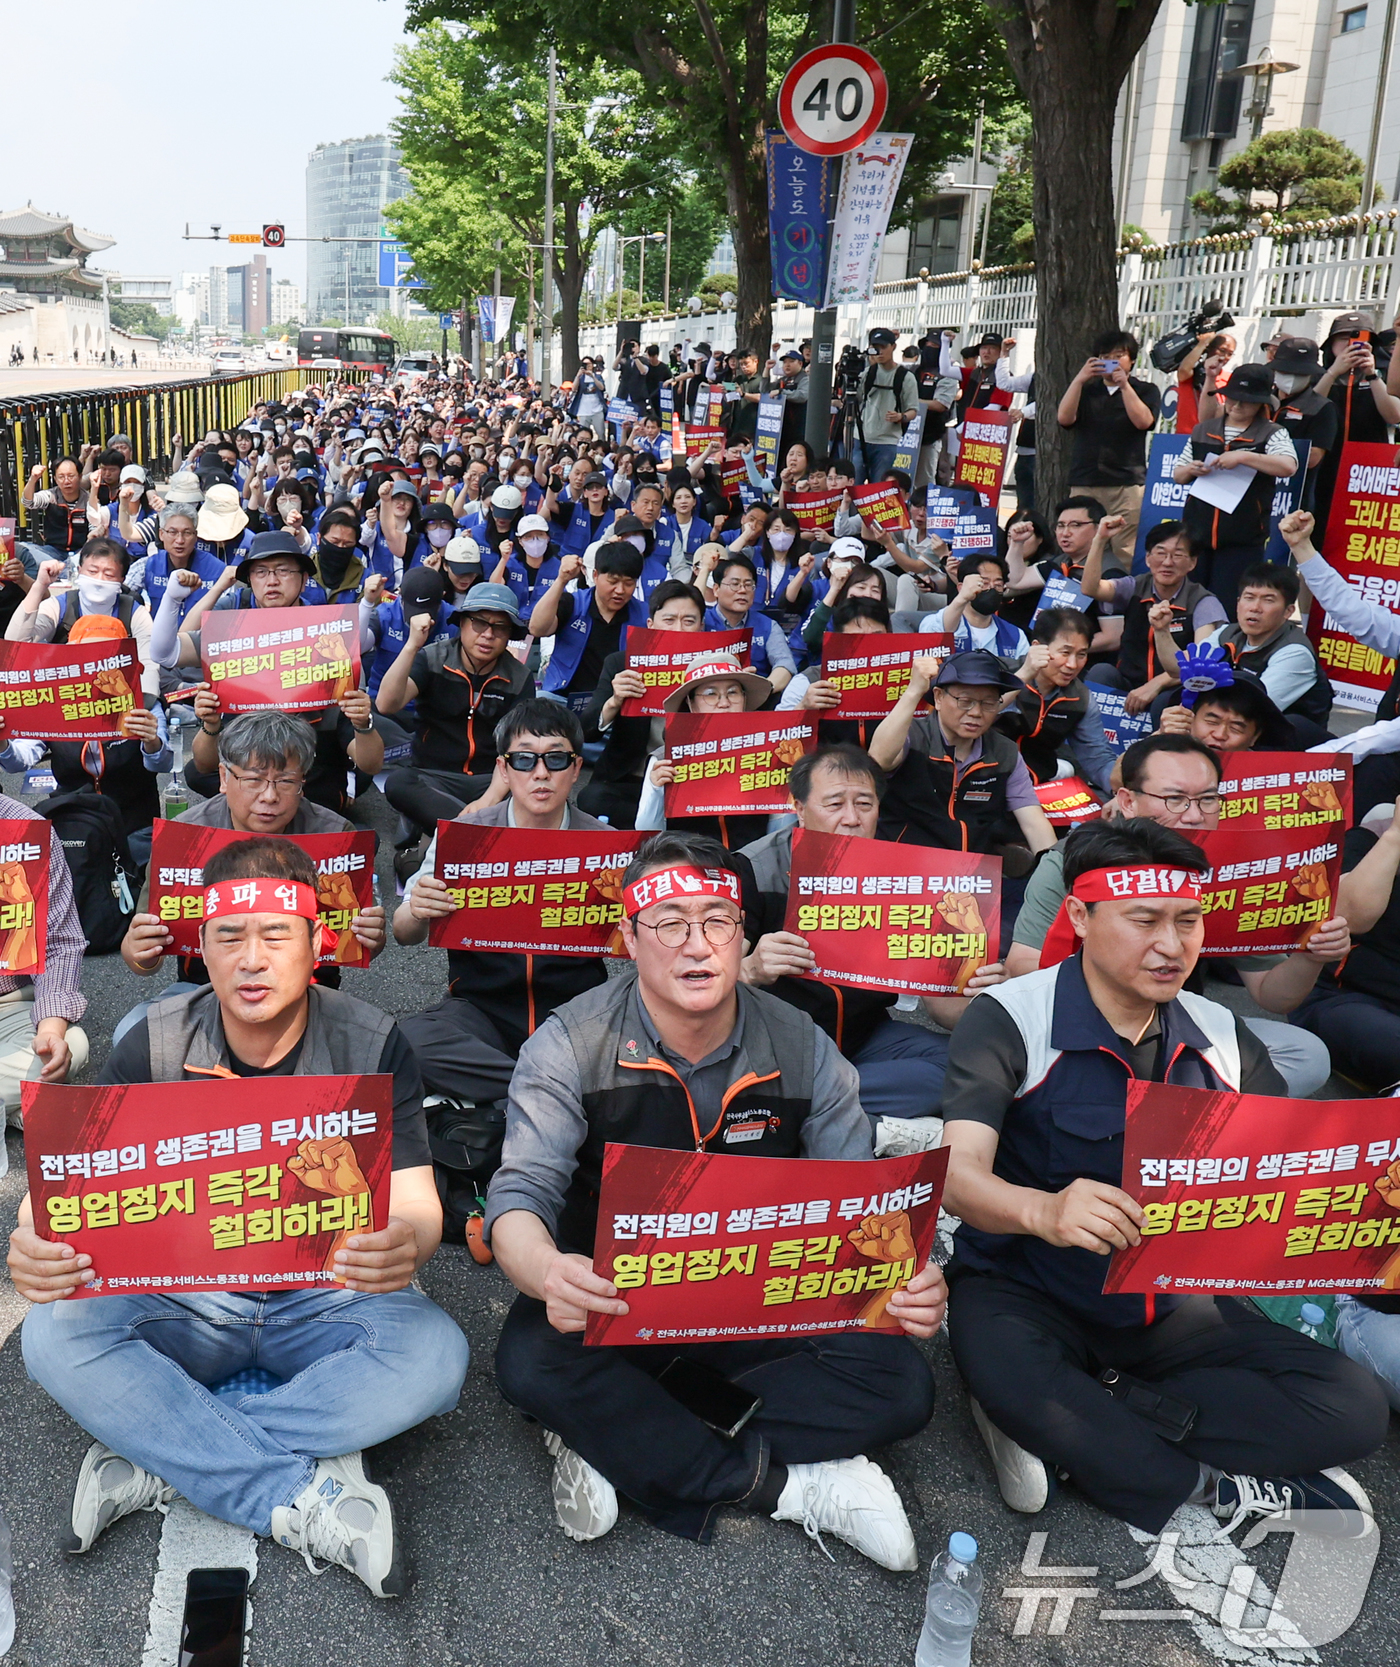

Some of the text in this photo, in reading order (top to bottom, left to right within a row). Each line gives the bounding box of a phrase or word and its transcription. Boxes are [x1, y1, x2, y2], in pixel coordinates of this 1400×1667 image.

[803, 77, 863, 122] 40
[787, 155, 808, 216] 오늘도
[858, 170, 886, 180] 우리가
[268, 230, 280, 242] 40
[1345, 499, 1389, 530] 그러나
[960, 536, 992, 547] 진행하라
[510, 571, 523, 582] 단결
[207, 619, 354, 657] 전직원의 생존권을 무시하는
[33, 664, 81, 683] 생존권을
[83, 653, 133, 675] 무시하는
[209, 645, 313, 681] 영업정지 즉각
[629, 653, 669, 668] 전직원의
[827, 656, 868, 672] 전직원의
[870, 651, 911, 668] 생존권을
[1318, 636, 1384, 676] 직원들에
[279, 658, 352, 690] 철회하라!
[643, 671, 686, 687] 업정지
[58, 682, 92, 701] 즉각
[61, 693, 134, 721] 철회하라!
[1119, 718, 1141, 731] 즉각
[671, 725, 812, 760] 전직원의 생존권을 무시하는
[672, 751, 773, 784] 영업정지 즉각
[1241, 772, 1291, 791] 생존권을
[1293, 768, 1346, 785] 무시하는
[1263, 792, 1300, 812] 즉각
[314, 853, 366, 876] 시하는
[442, 851, 637, 880] 전직원의 생존권을 무시하
[1217, 842, 1338, 883] 생존권을 무시하는
[542, 881, 590, 903] 즉각
[632, 868, 739, 909] 단결 투쟁
[798, 876, 993, 895] 전직원의 생존권을 무시하는
[1106, 868, 1159, 897] 단결
[1242, 881, 1289, 908] 즉각
[797, 904, 934, 932] 영업정지 즉각
[1236, 896, 1331, 933] 철회하라!
[474, 940, 561, 952] 전국사무금융서비스노동조합
[887, 932, 987, 960] 철회하라!
[823, 968, 909, 989] 전국사무금융서비스노동조합
[39, 1108, 378, 1181] 전직원의 생존권을 무시하는
[1139, 1143, 1360, 1187] 전직원의 생존권을
[46, 1163, 283, 1233] 영업정지 즉각
[612, 1182, 933, 1240] 전직원의 생존권을 무시하는
[1140, 1182, 1369, 1236] 영업정지 즉각
[208, 1192, 370, 1250] 철회하라!
[611, 1235, 842, 1289] 영업정지 즉각
[107, 1270, 338, 1288] 전국사무금융서비스노동조합 MG손해보험지부
[762, 1257, 916, 1306] 철회하라!
[1174, 1277, 1386, 1290] 전국사무금융서비스노동조합 MG손해보험지부
[656, 1317, 868, 1339] 전국사무금융서비스노동조합 MG손해보험지부
